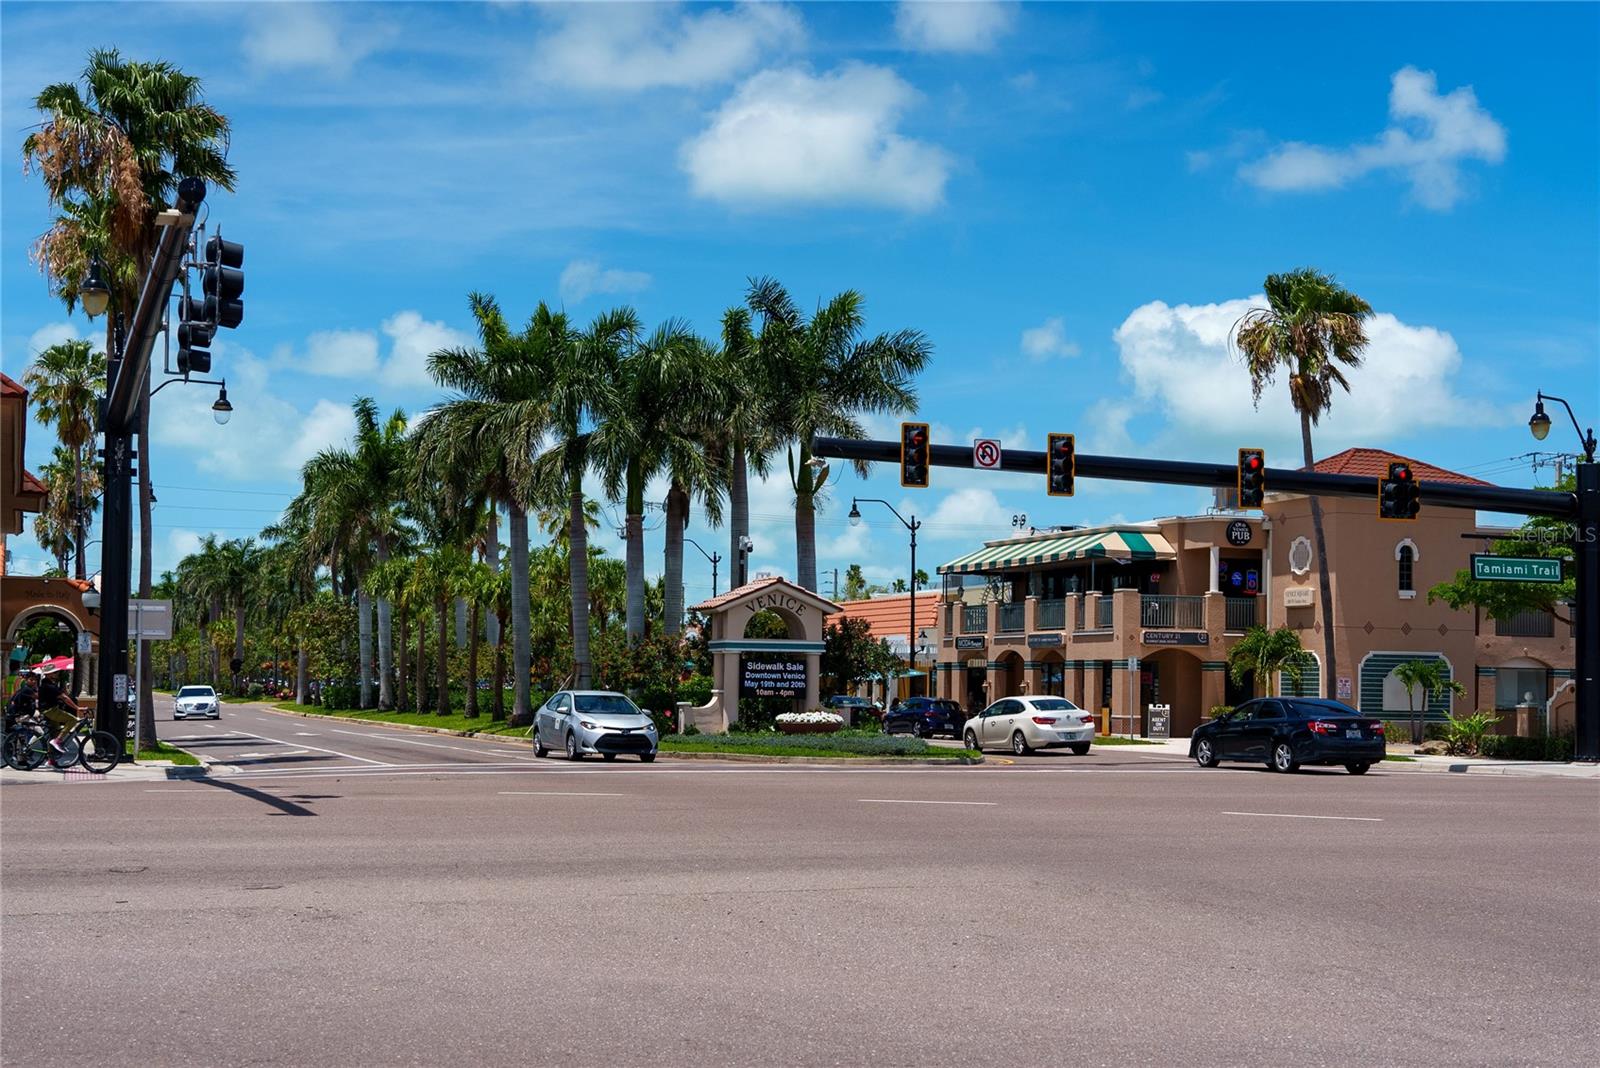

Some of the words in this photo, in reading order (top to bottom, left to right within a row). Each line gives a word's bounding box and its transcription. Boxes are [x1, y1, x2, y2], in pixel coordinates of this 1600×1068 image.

[1232, 532, 1250, 540] PUB
[1476, 562, 1528, 574] Tamiami
[1532, 564, 1559, 576] Trail
[746, 594, 806, 616] VENICE
[747, 662, 784, 670] Sidewalk
[786, 662, 804, 670] Sale
[744, 680, 758, 689] May
[779, 689, 795, 697] 4pm
